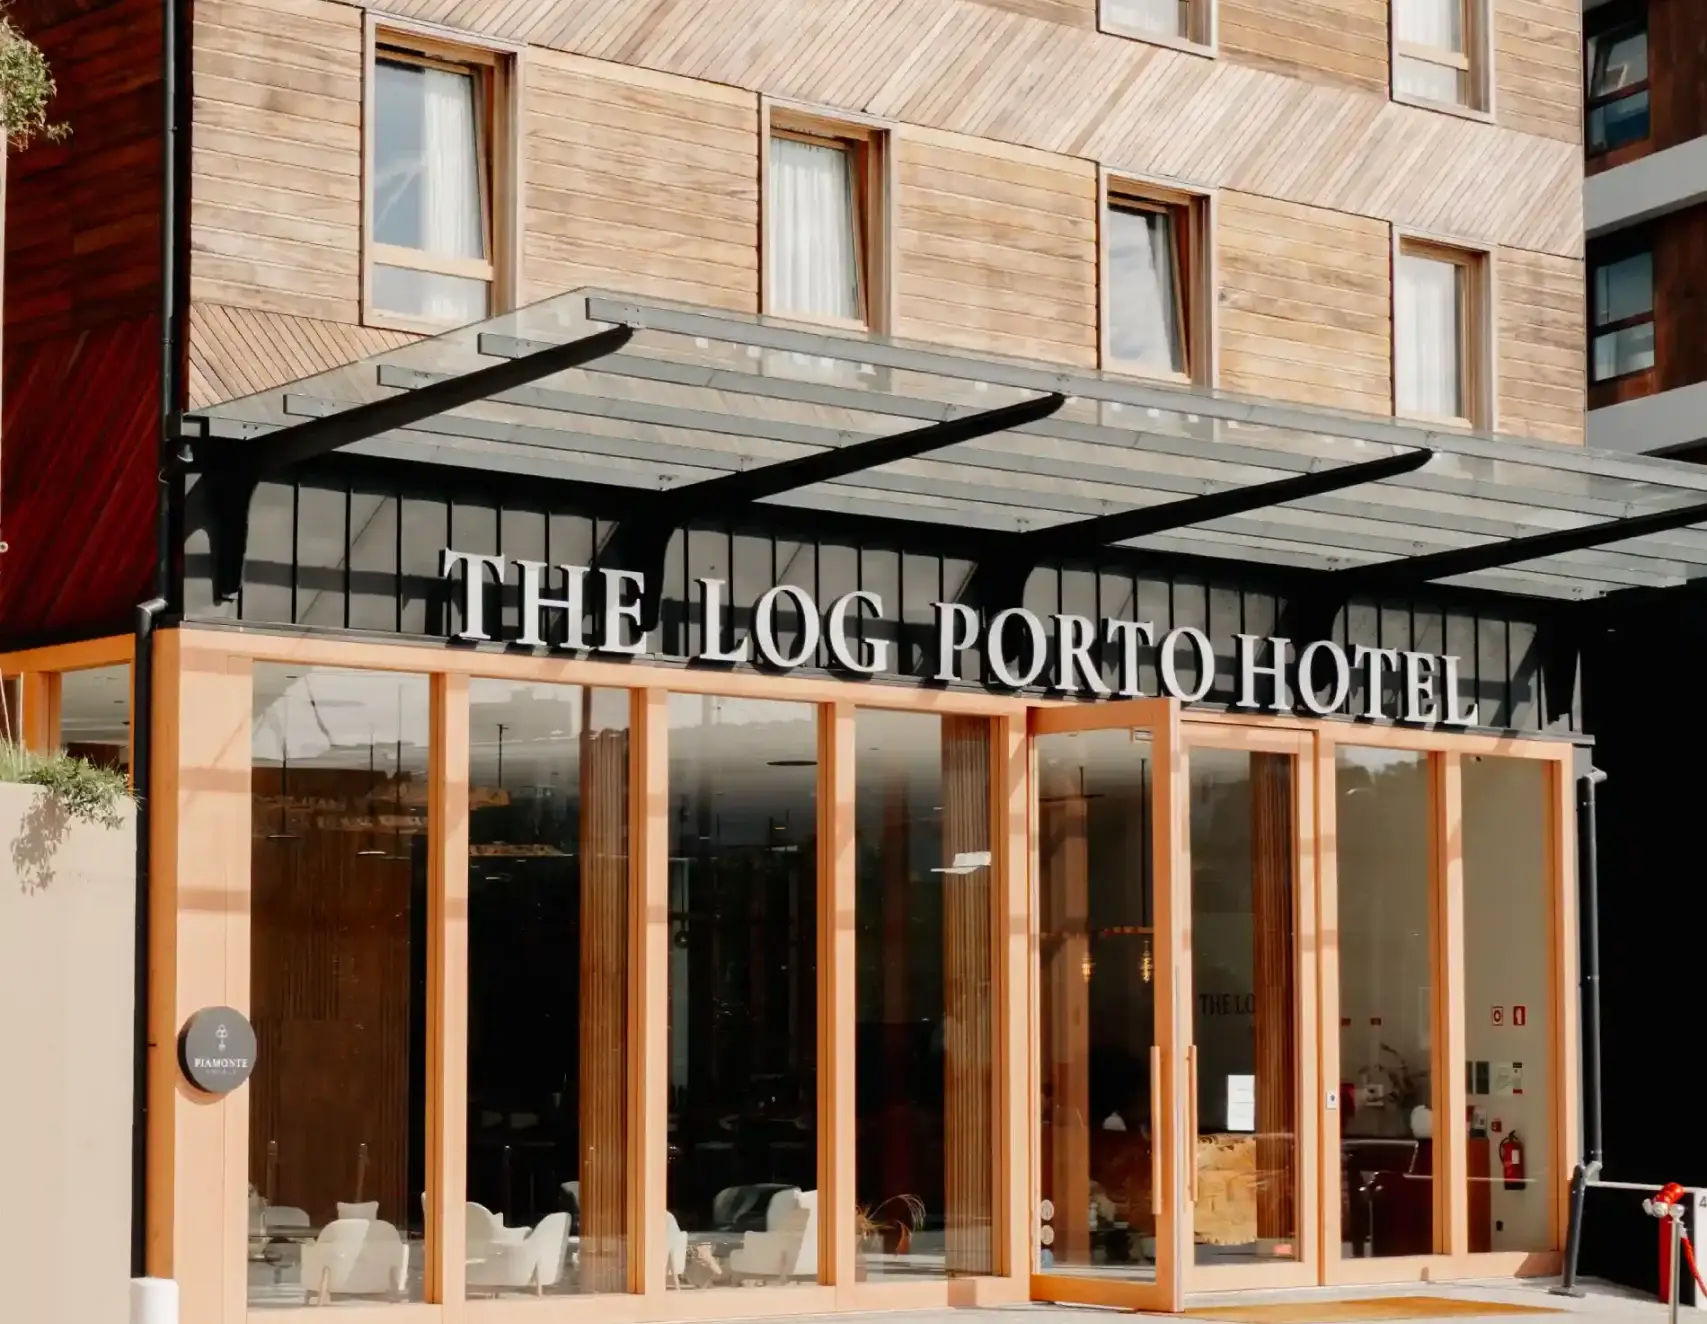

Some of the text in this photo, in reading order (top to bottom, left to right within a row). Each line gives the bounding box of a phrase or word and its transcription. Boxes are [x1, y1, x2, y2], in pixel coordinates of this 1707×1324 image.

[444, 547, 1478, 726] THE LOG PORTO HOTEL
[1199, 993, 1231, 1015] THE
[194, 1058, 248, 1068] PIAMONTE
